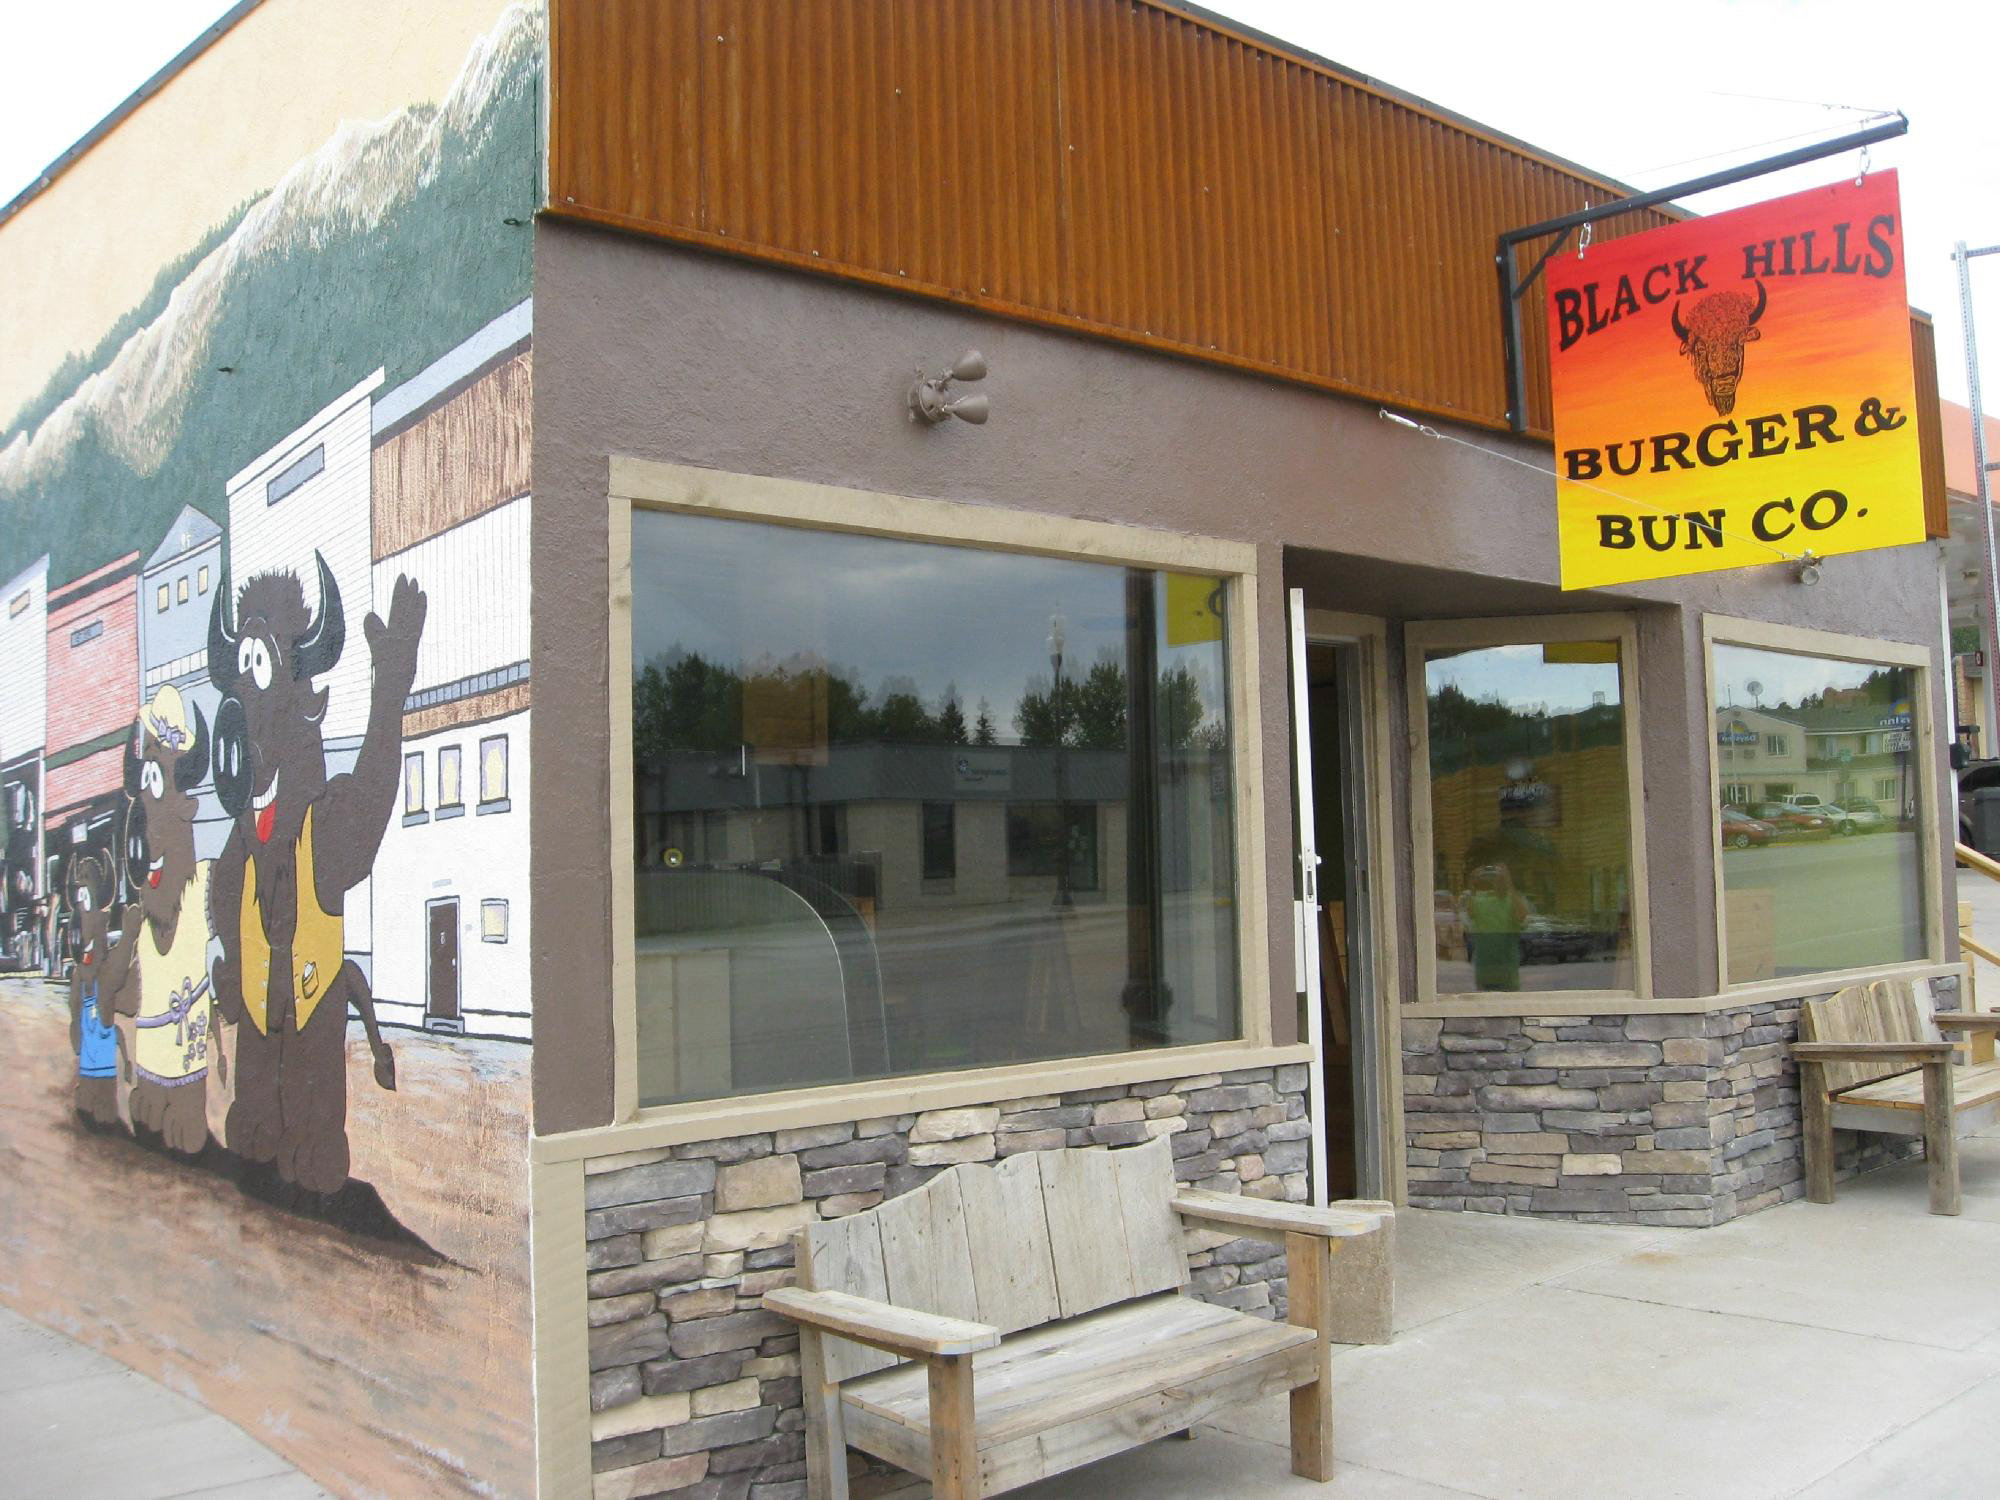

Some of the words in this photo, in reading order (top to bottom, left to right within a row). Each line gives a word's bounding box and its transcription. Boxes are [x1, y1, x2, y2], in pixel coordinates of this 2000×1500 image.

[1554, 254, 1708, 353] BLACK
[1741, 213, 1896, 279] HILLS
[1563, 404, 1845, 481] BURGER
[1854, 397, 1908, 437] &
[1596, 508, 1727, 552] BUN
[1751, 489, 1869, 542] CO.
